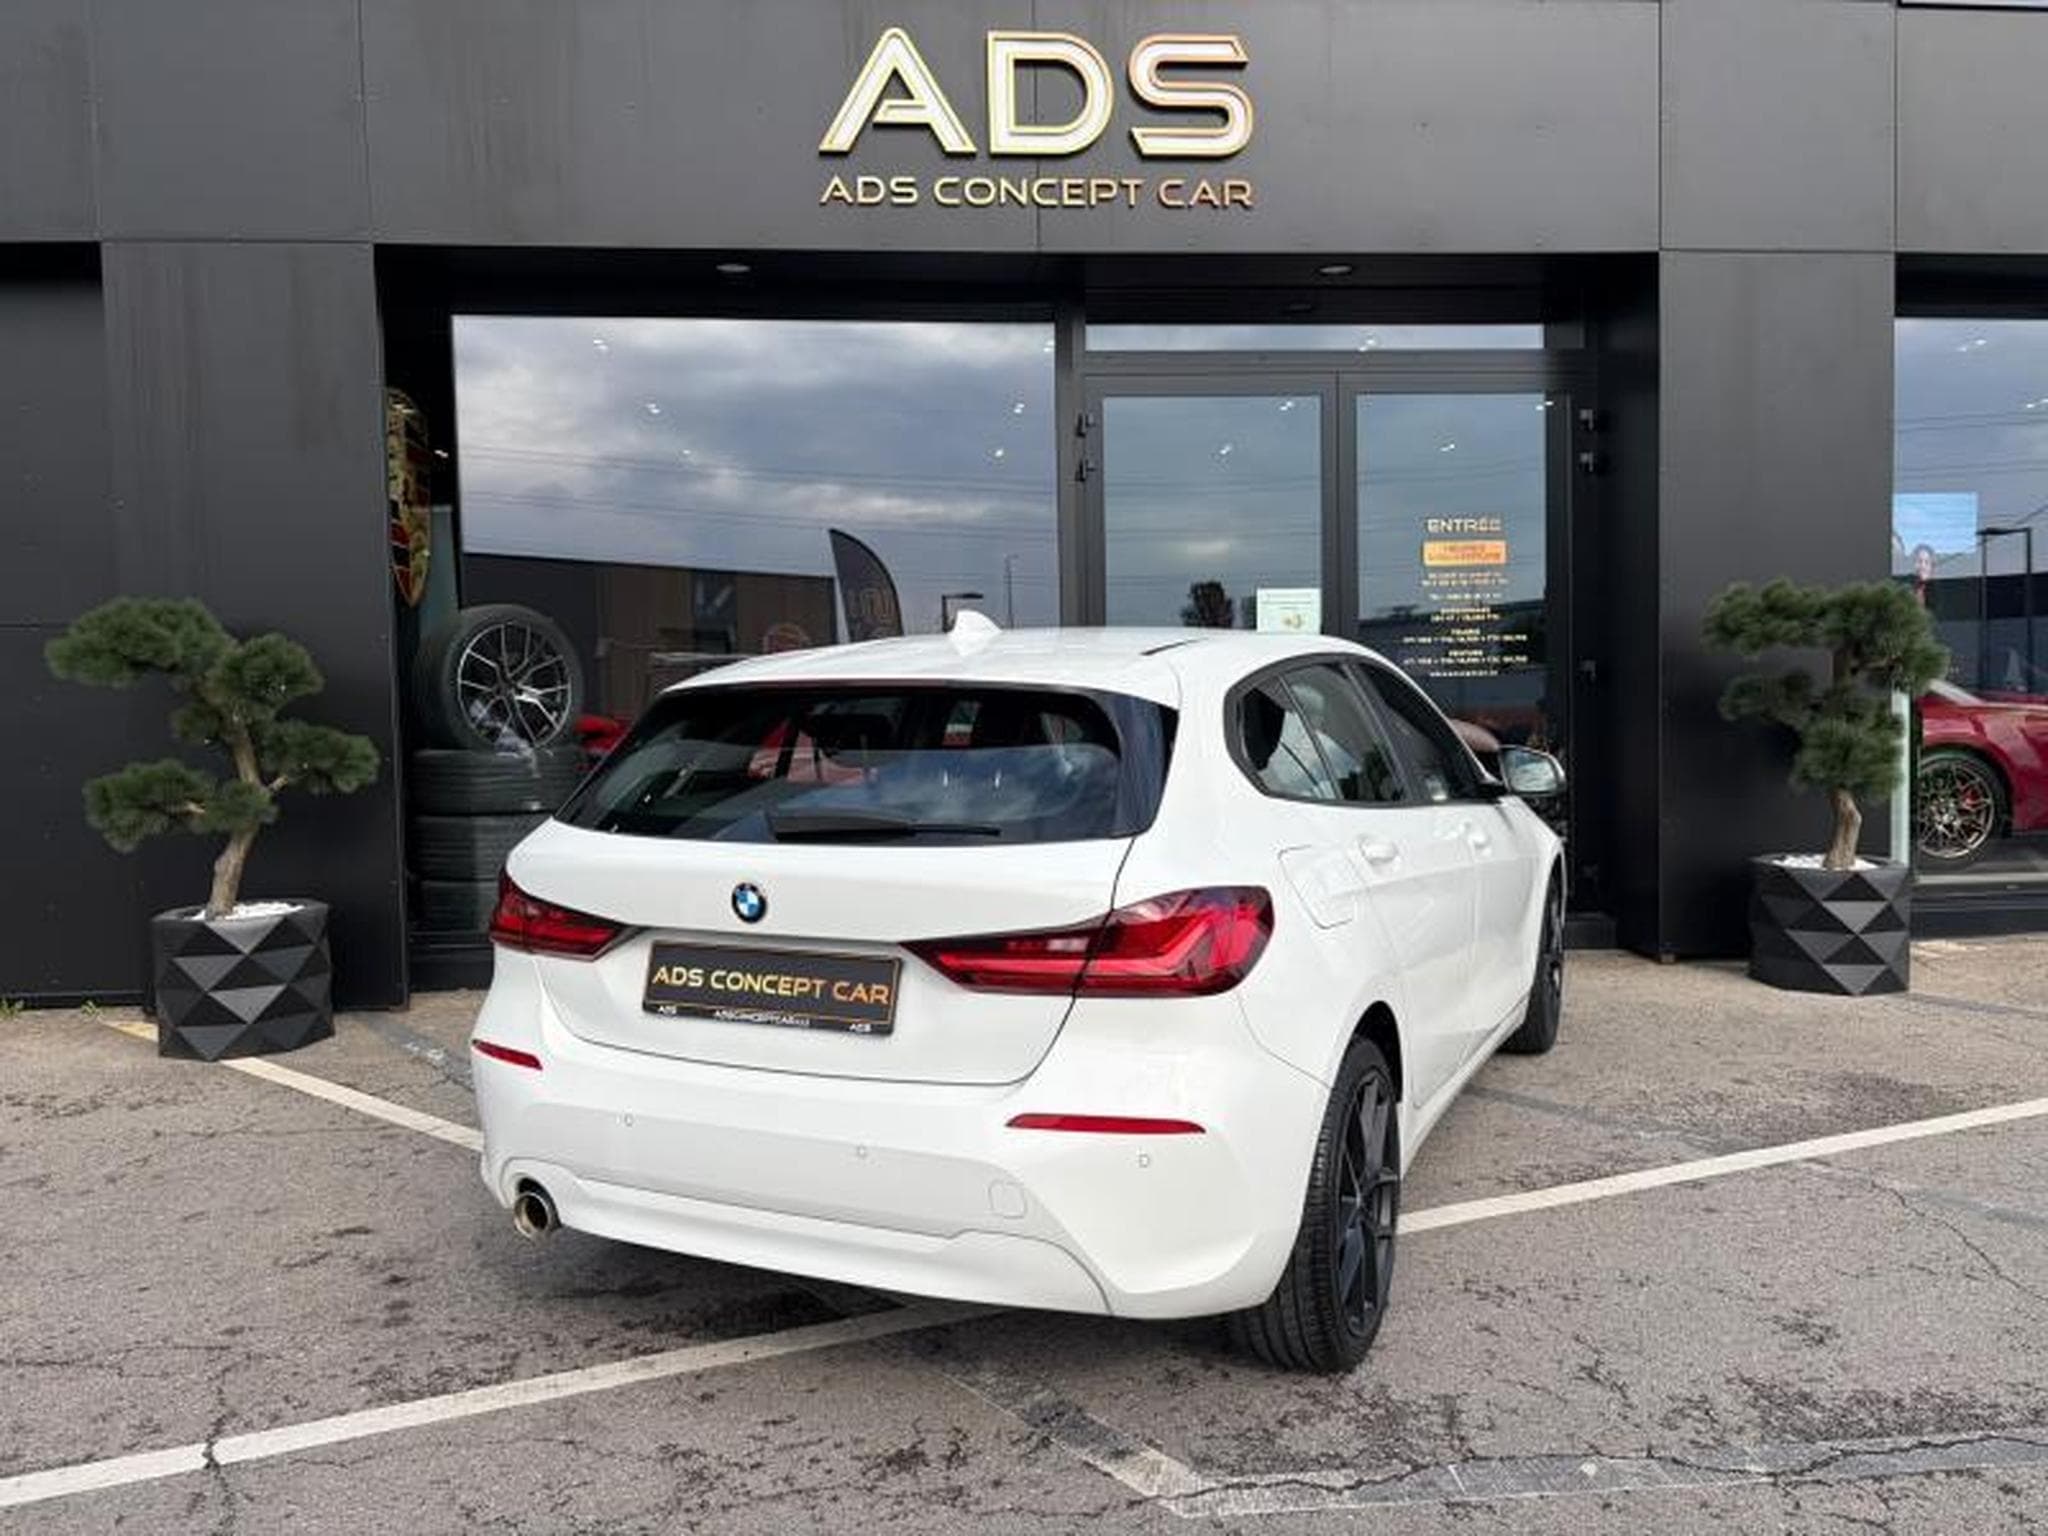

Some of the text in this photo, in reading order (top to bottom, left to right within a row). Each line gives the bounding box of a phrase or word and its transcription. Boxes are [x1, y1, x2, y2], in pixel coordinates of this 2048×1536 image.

[819, 27, 1253, 156] ADS
[819, 175, 1254, 208] ADS CONCEPT CAR
[652, 966, 890, 1005] ADS CONCEPT CAR
